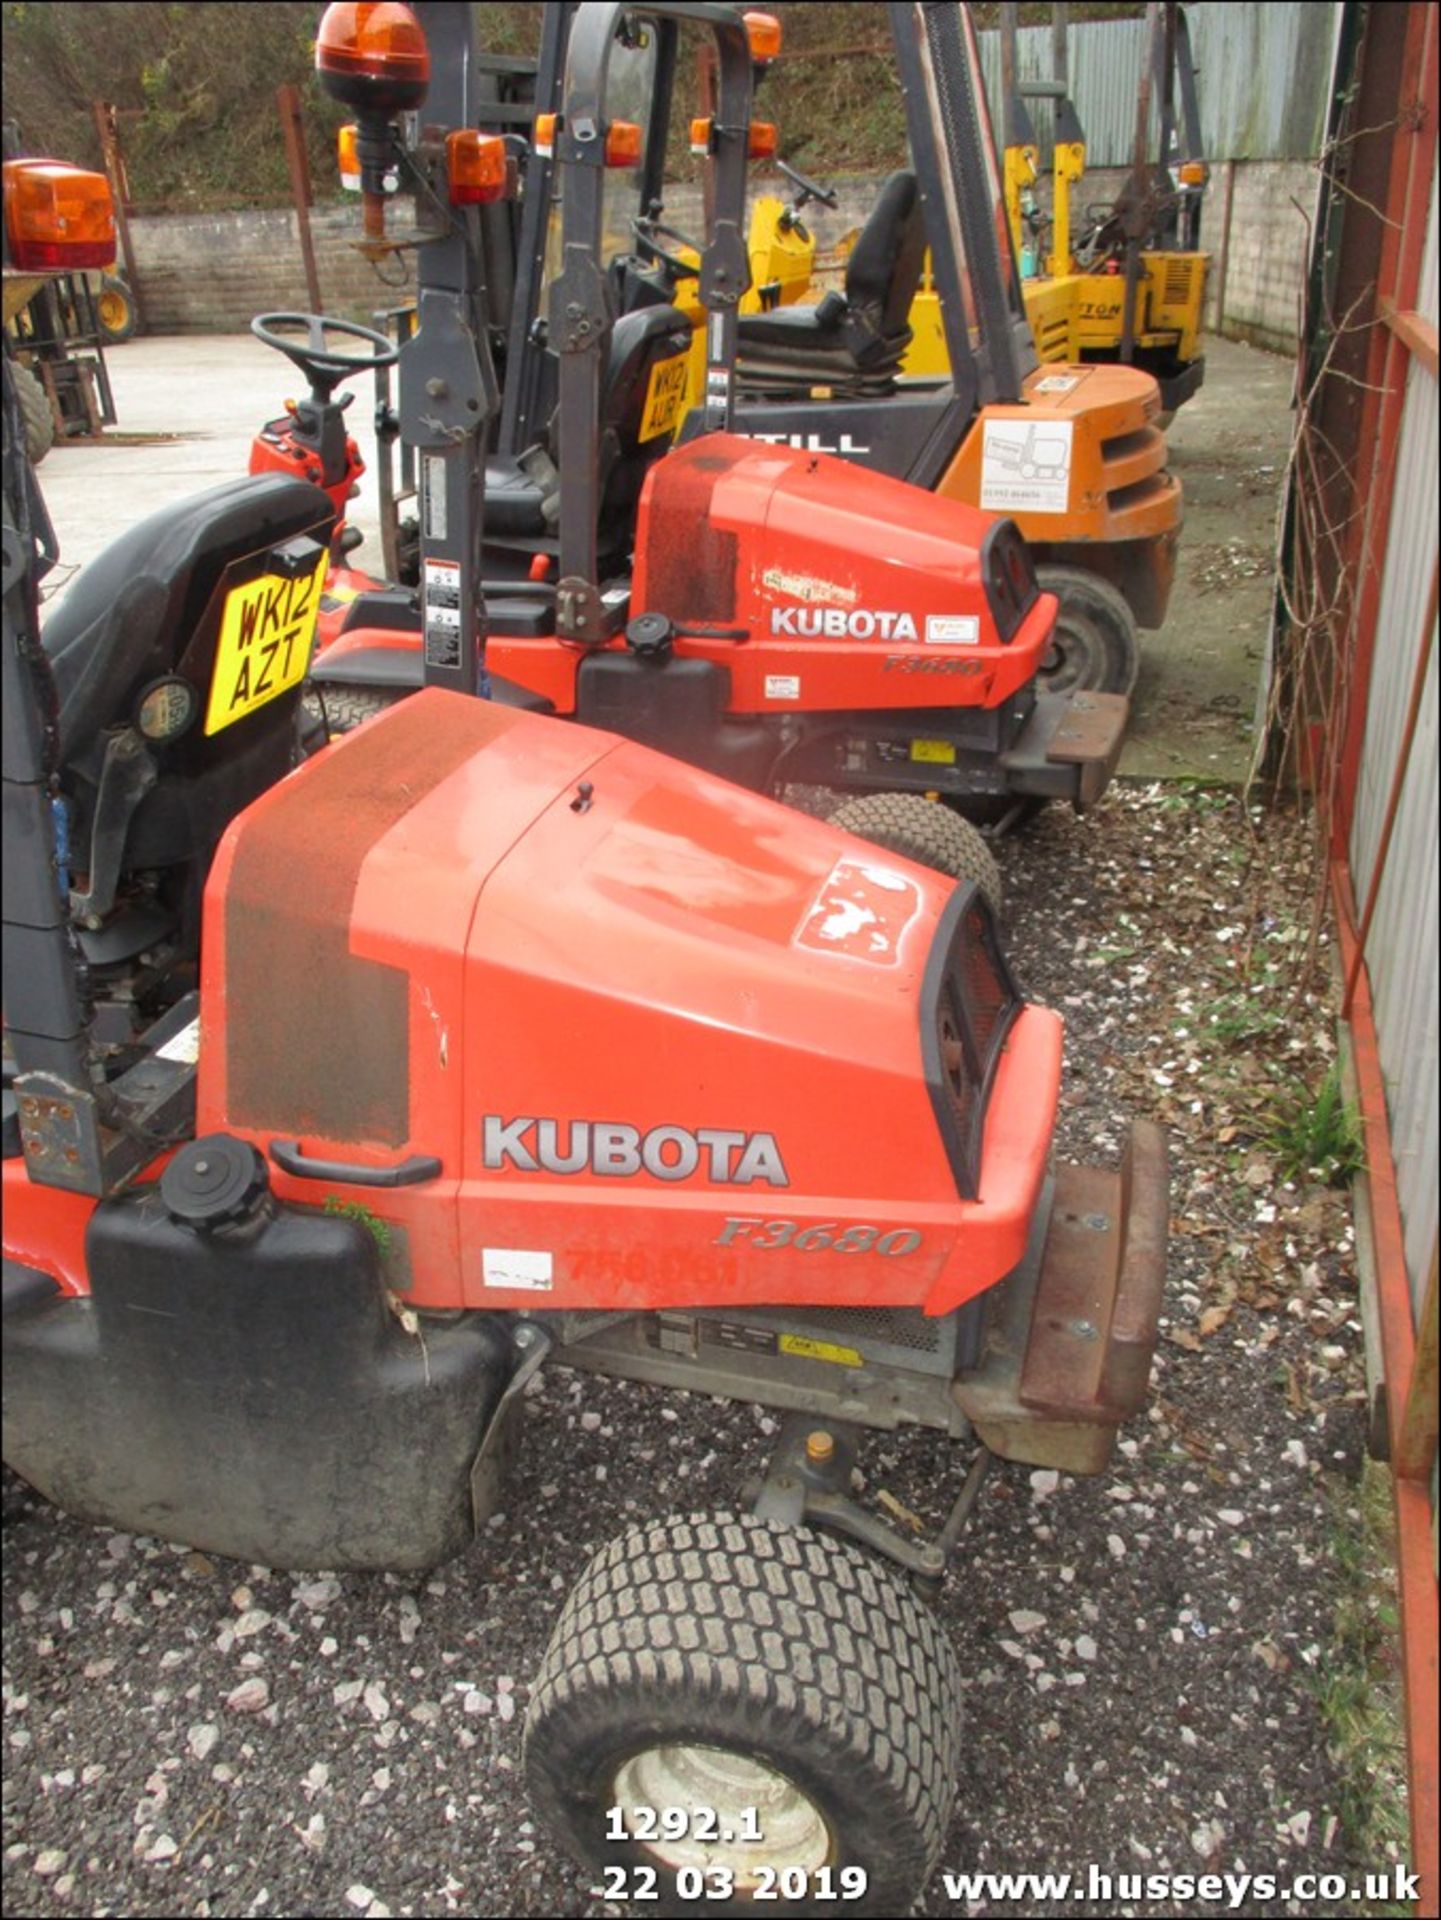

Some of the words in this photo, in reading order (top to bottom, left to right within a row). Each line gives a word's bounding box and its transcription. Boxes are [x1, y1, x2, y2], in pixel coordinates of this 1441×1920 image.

[733, 433, 870, 453] TILL
[238, 574, 315, 651] WK12
[771, 606, 918, 641] KUBOTA
[229, 628, 302, 711] AZT
[881, 654, 983, 676] F3680
[482, 1115, 790, 1187] KUBOTA
[712, 1215, 922, 1257] F3680
